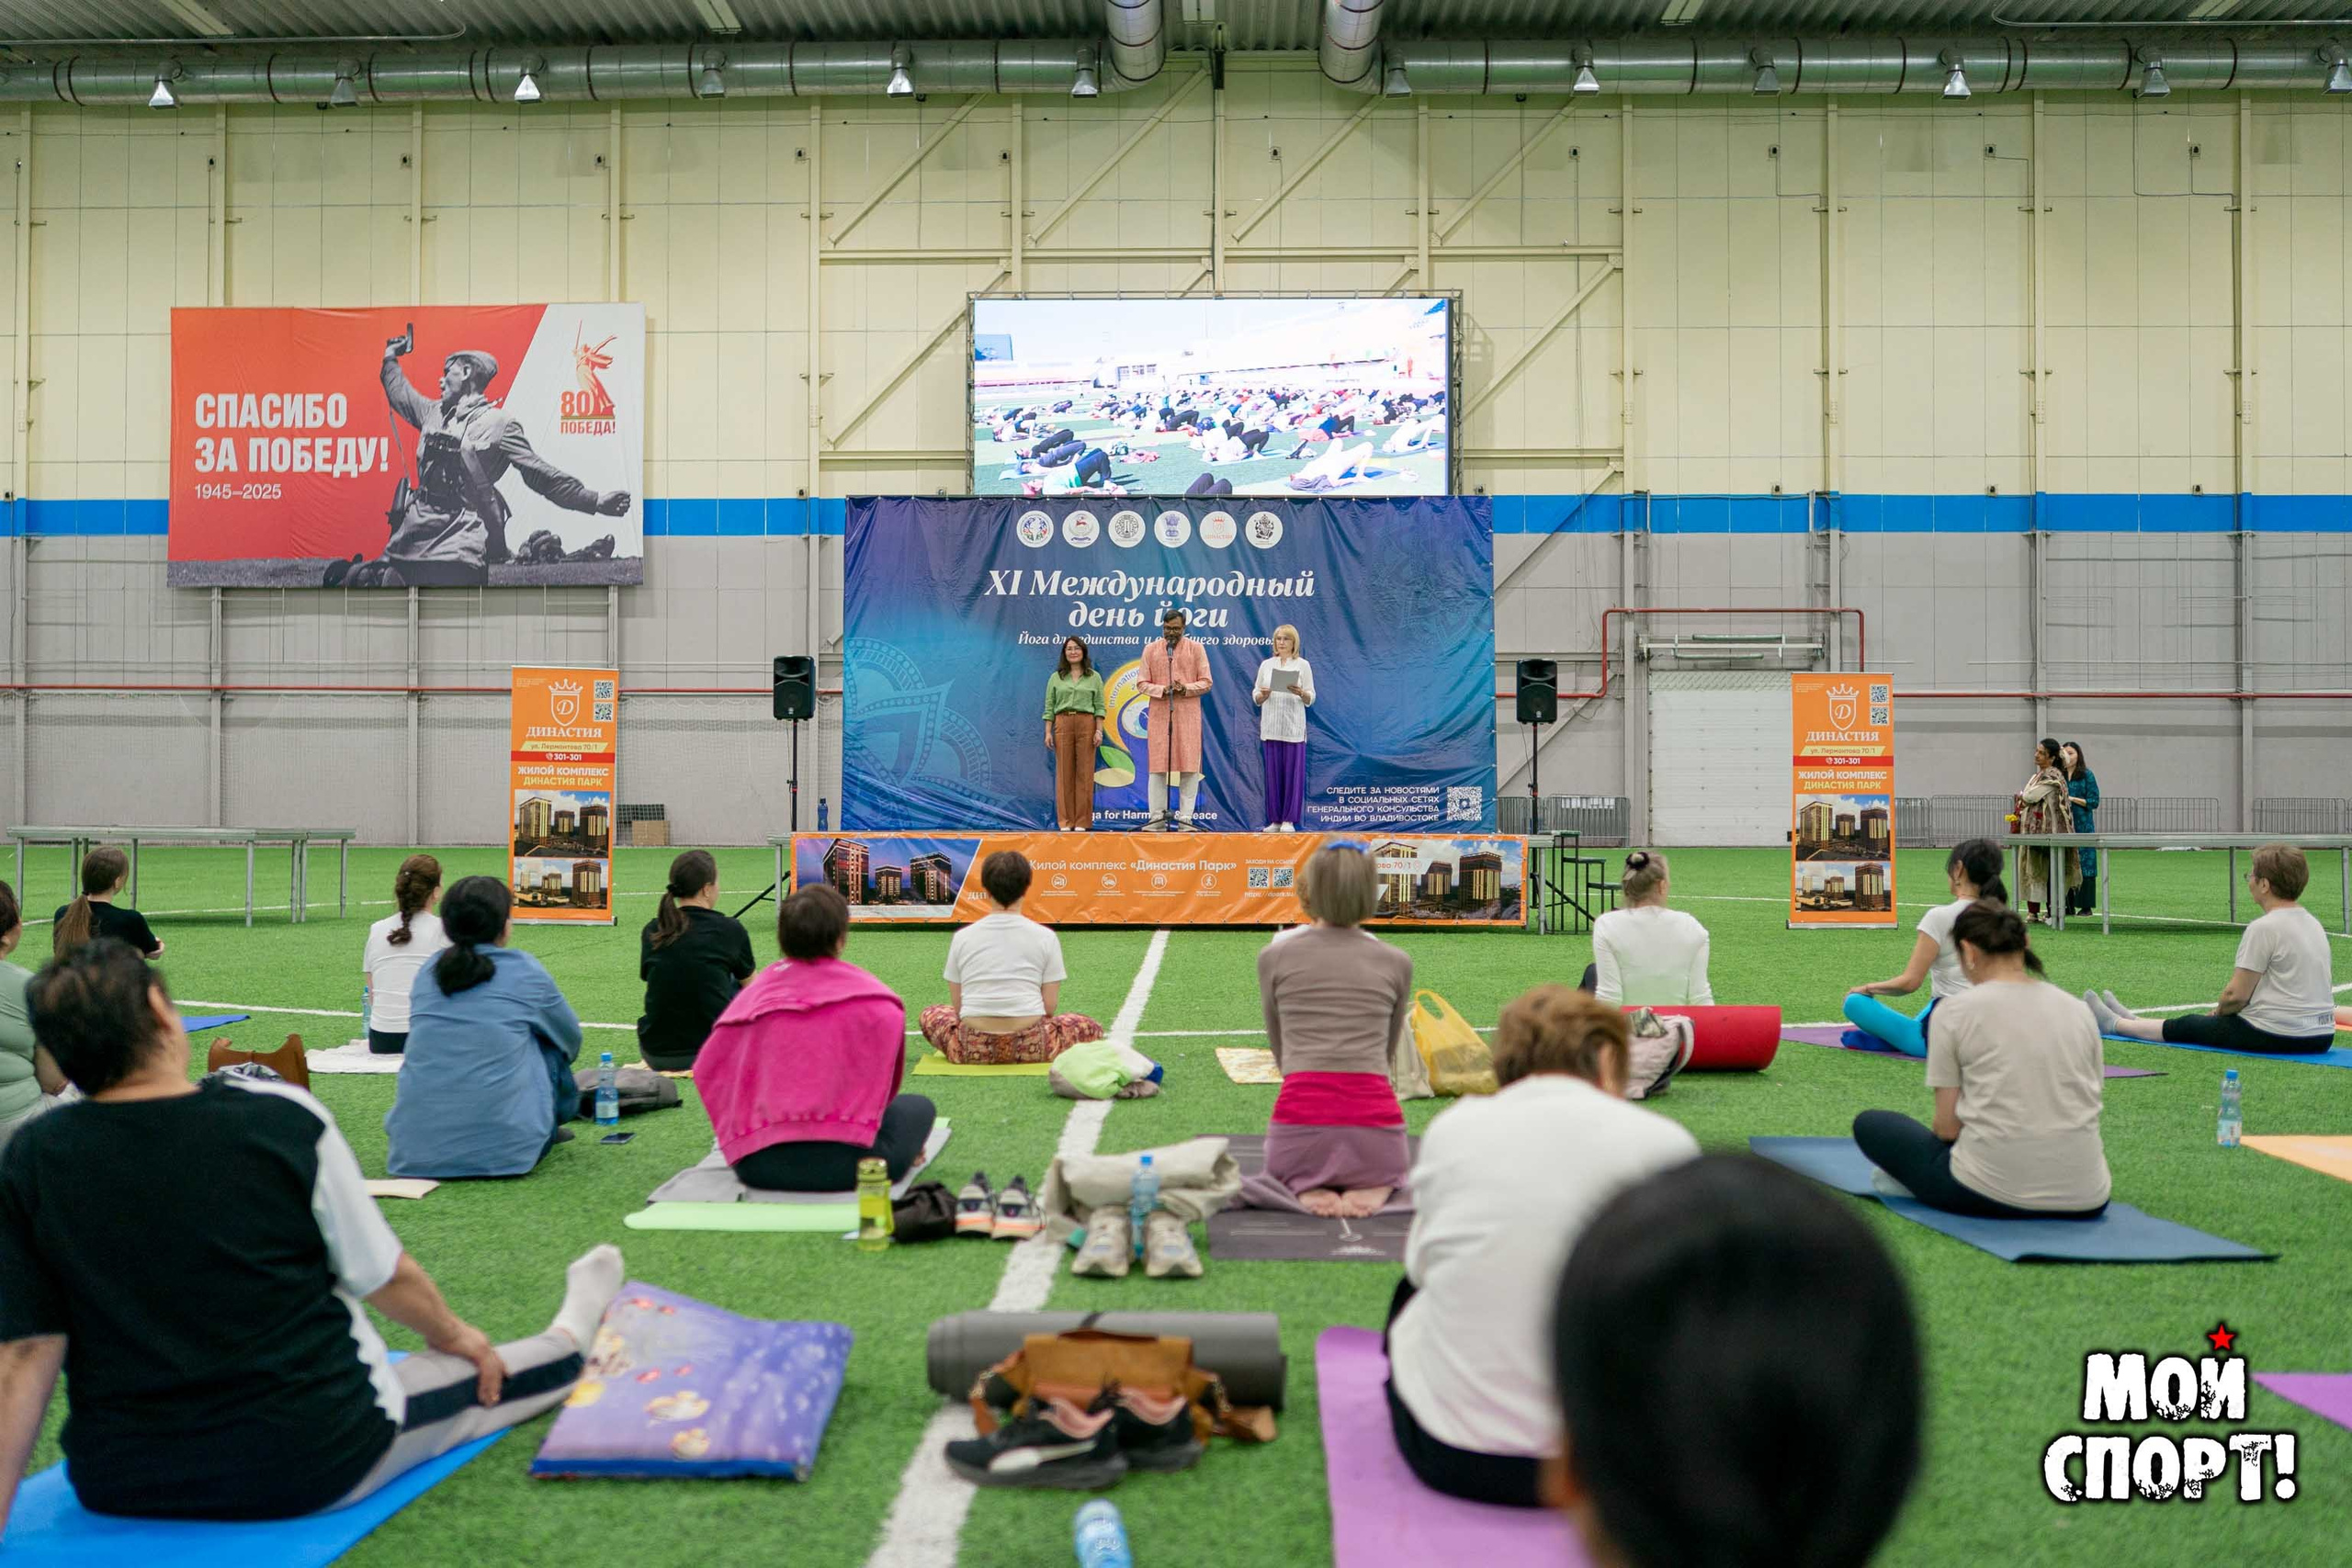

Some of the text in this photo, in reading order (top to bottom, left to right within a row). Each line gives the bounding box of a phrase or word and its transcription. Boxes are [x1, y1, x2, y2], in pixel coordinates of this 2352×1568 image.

[560, 390, 591, 417] 80
[194, 392, 348, 429] СПАСИБО
[560, 421, 616, 435] ПОБЕДА!
[194, 437, 390, 479] ЗА ПОБЕДУ!
[984, 570, 1316, 603] XI Международный
[1068, 601, 1145, 628] день
[1018, 631, 1049, 645] Йога
[1108, 668, 1140, 708] Internatio
[525, 726, 602, 738] ДИНАСТИЯ
[1804, 731, 1880, 742] ДИНАСТИЯ
[517, 764, 609, 776] ЖИЛОЙ КОМПЛЕКС
[1798, 769, 1887, 780] ЖИЛОЙ КОМПЛЕКС
[523, 776, 603, 786] ДИНАСТИЯ ПАРК
[1804, 781, 1882, 790] ДИНАСТИЯ ПАРК
[1326, 786, 1440, 795] СЛЕДИТЕ ЗА НОВОСТЯМИ
[1339, 795, 1440, 805] В СОЦИАЛЬНЫХ СЕТЯХ
[1104, 810, 1119, 819] for
[1193, 811, 1218, 819] eace
[1307, 805, 1440, 813] ГЕНЕРАЛЬНОГО КОНСУЛЬСТВА
[1320, 814, 1440, 822] ИНДИИ ВО ВЛАДИВОСТОКЕ
[1069, 862, 1127, 871] комплекс
[1130, 859, 1196, 872] «Династия
[1199, 859, 1238, 872] Парк»
